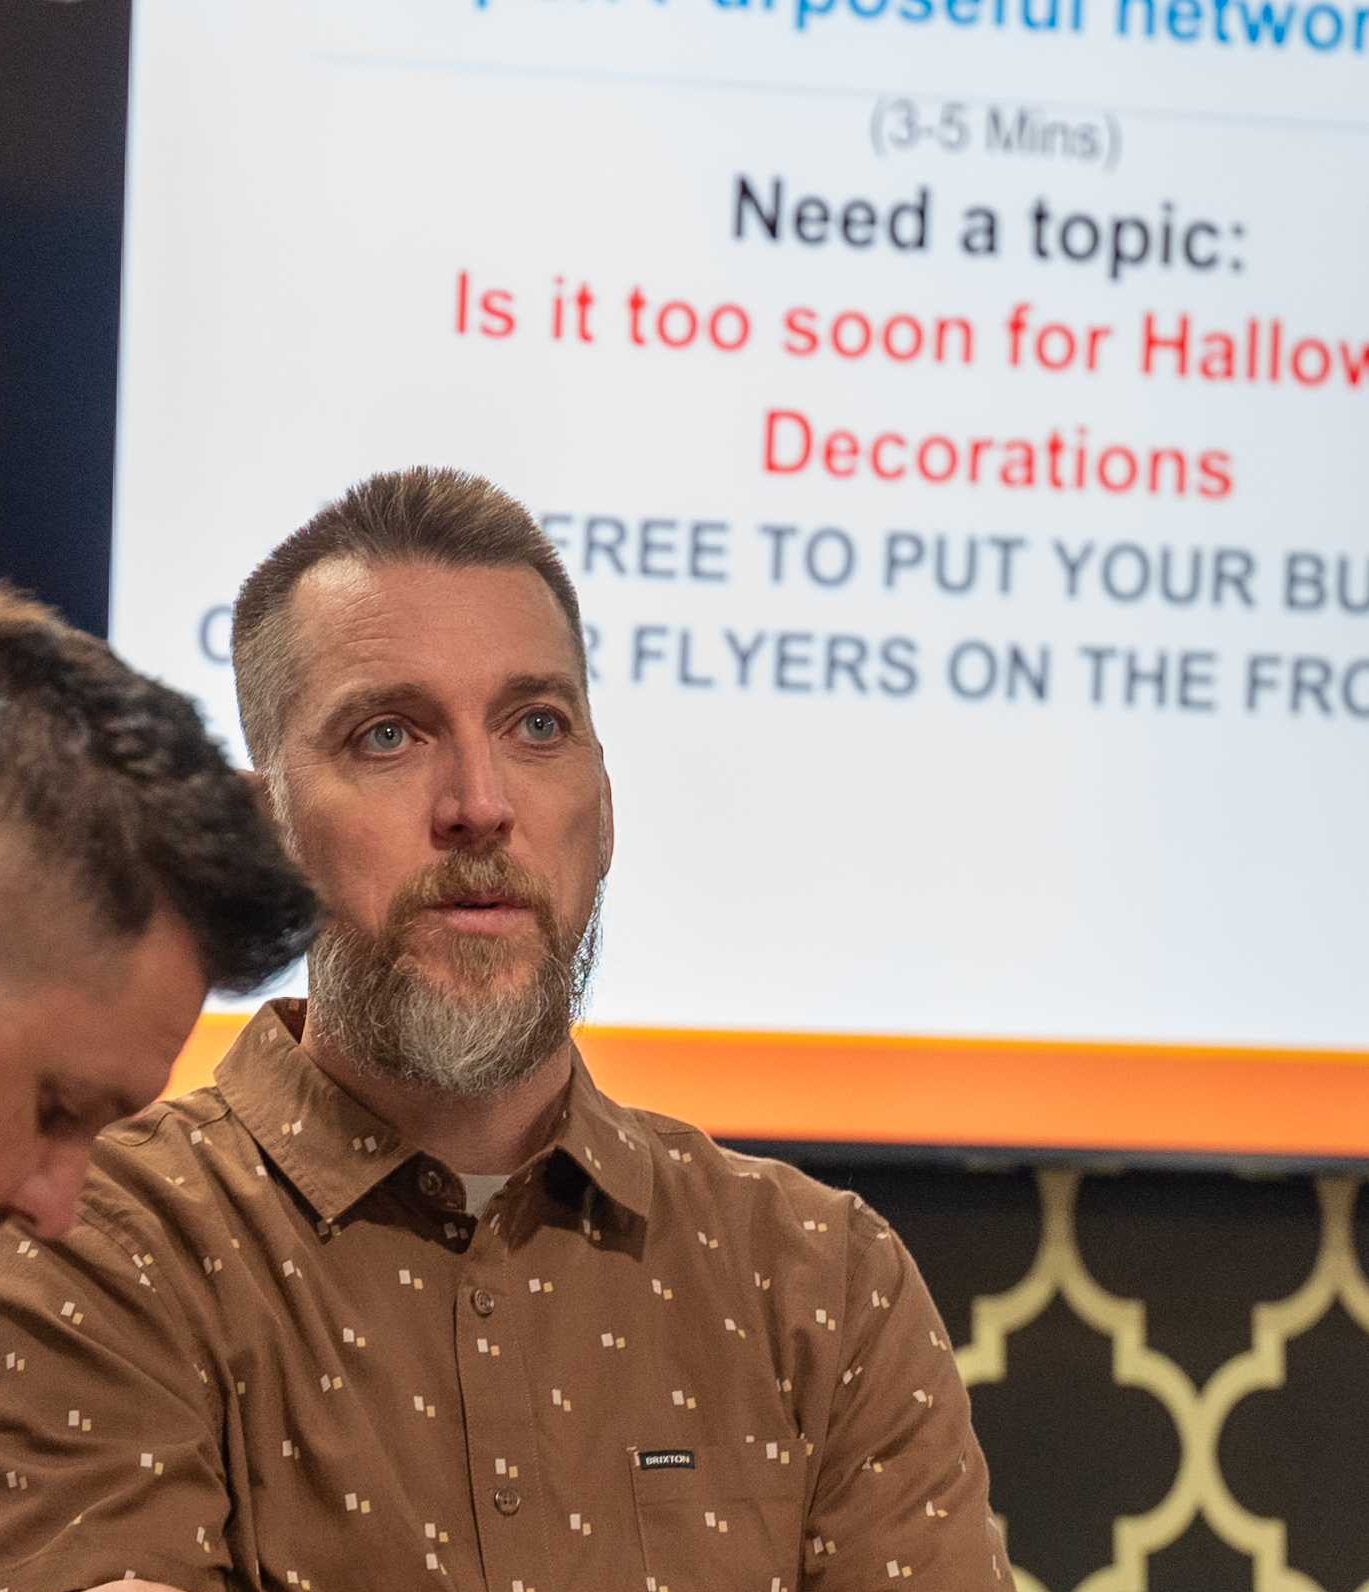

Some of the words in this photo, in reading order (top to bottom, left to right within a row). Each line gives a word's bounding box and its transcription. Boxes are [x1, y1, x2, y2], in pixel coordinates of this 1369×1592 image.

[869, 96, 972, 157] (3-5
[985, 103, 1122, 169] Mins)
[733, 174, 931, 252] Need
[960, 206, 999, 257] a
[1030, 199, 1244, 282] topic:
[455, 270, 516, 339] Is
[552, 277, 595, 344] it
[627, 286, 751, 352] too
[783, 307, 974, 364] soon
[1006, 303, 1111, 372] for
[763, 408, 1234, 500] Decorations
[758, 523, 858, 590] TO
[882, 530, 1028, 596] PUT
[1053, 540, 1258, 610] YOUR
[630, 624, 921, 699] FLYERS
[946, 639, 1051, 703] ON
[1079, 646, 1217, 714] THE
[645, 1454, 691, 1466] BRIXTON
